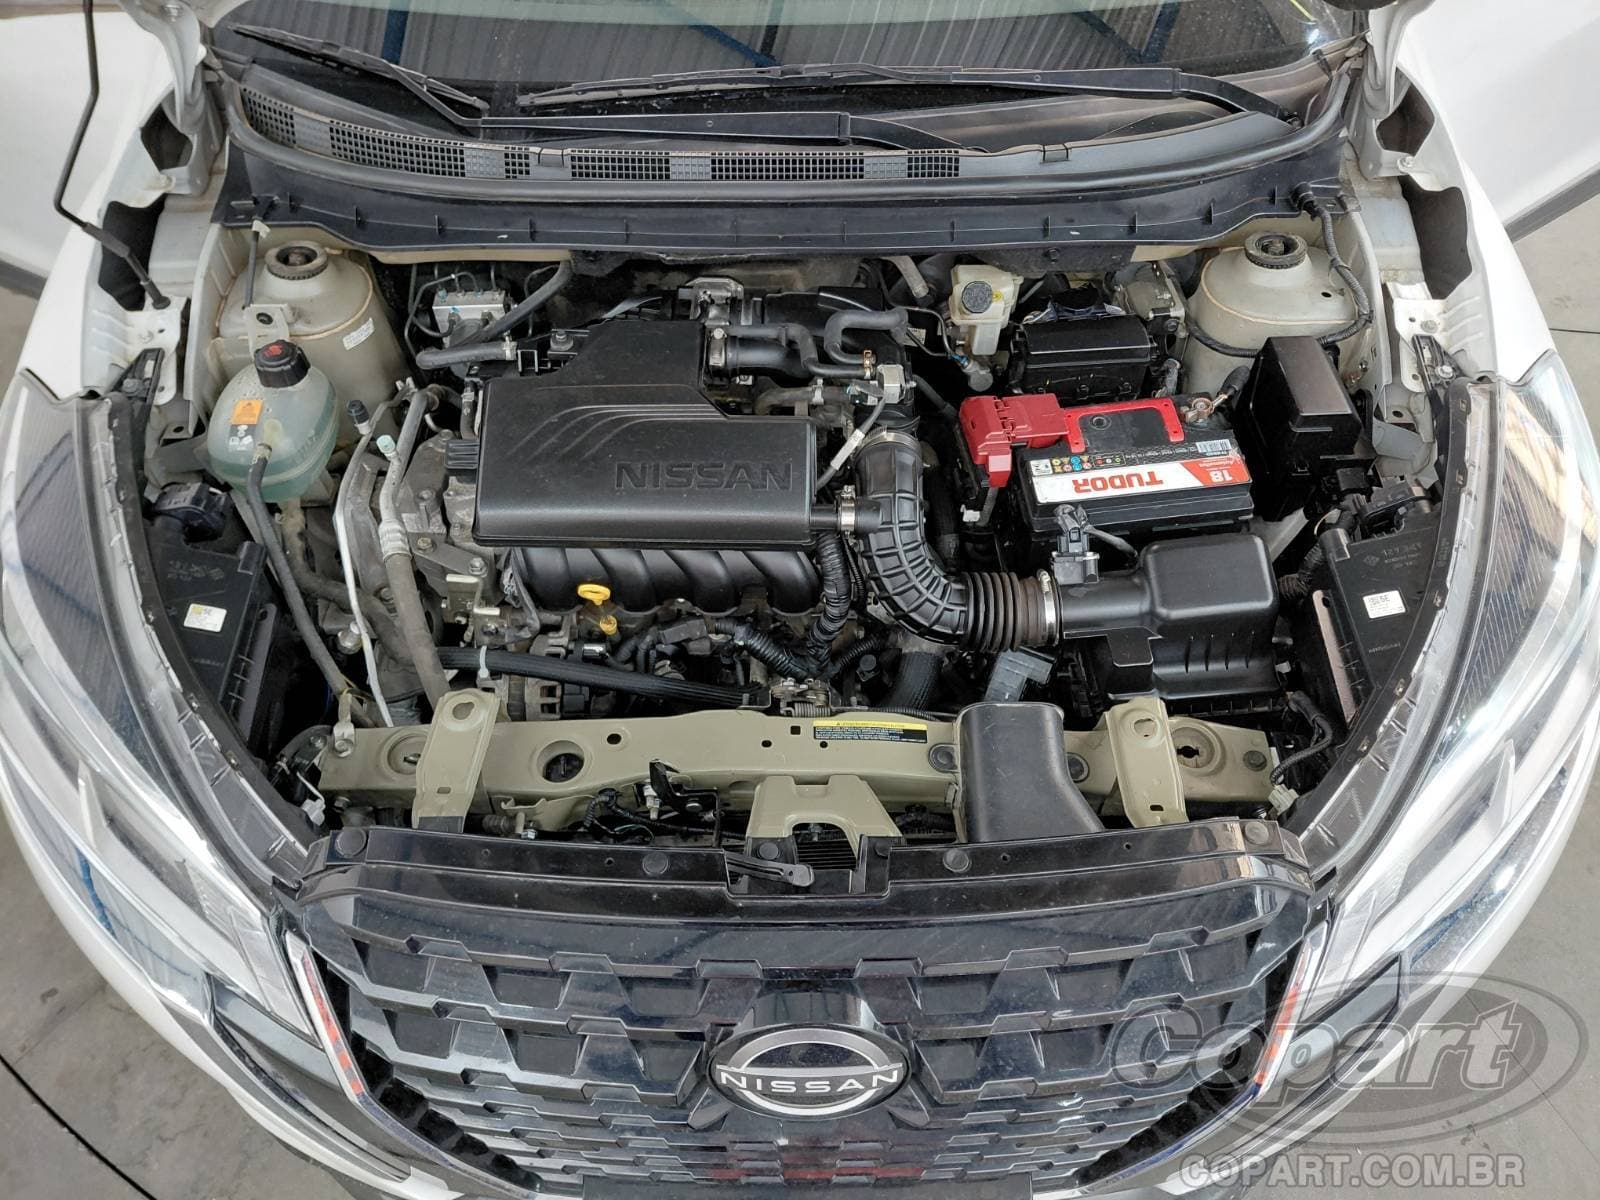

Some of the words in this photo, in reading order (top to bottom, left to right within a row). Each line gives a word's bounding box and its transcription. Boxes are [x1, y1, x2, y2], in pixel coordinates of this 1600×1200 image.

[615, 461, 793, 491] NISSAN
[1072, 471, 1164, 494] TUDOR
[1209, 470, 1233, 482] 18
[720, 1069, 898, 1093] NISSAN
